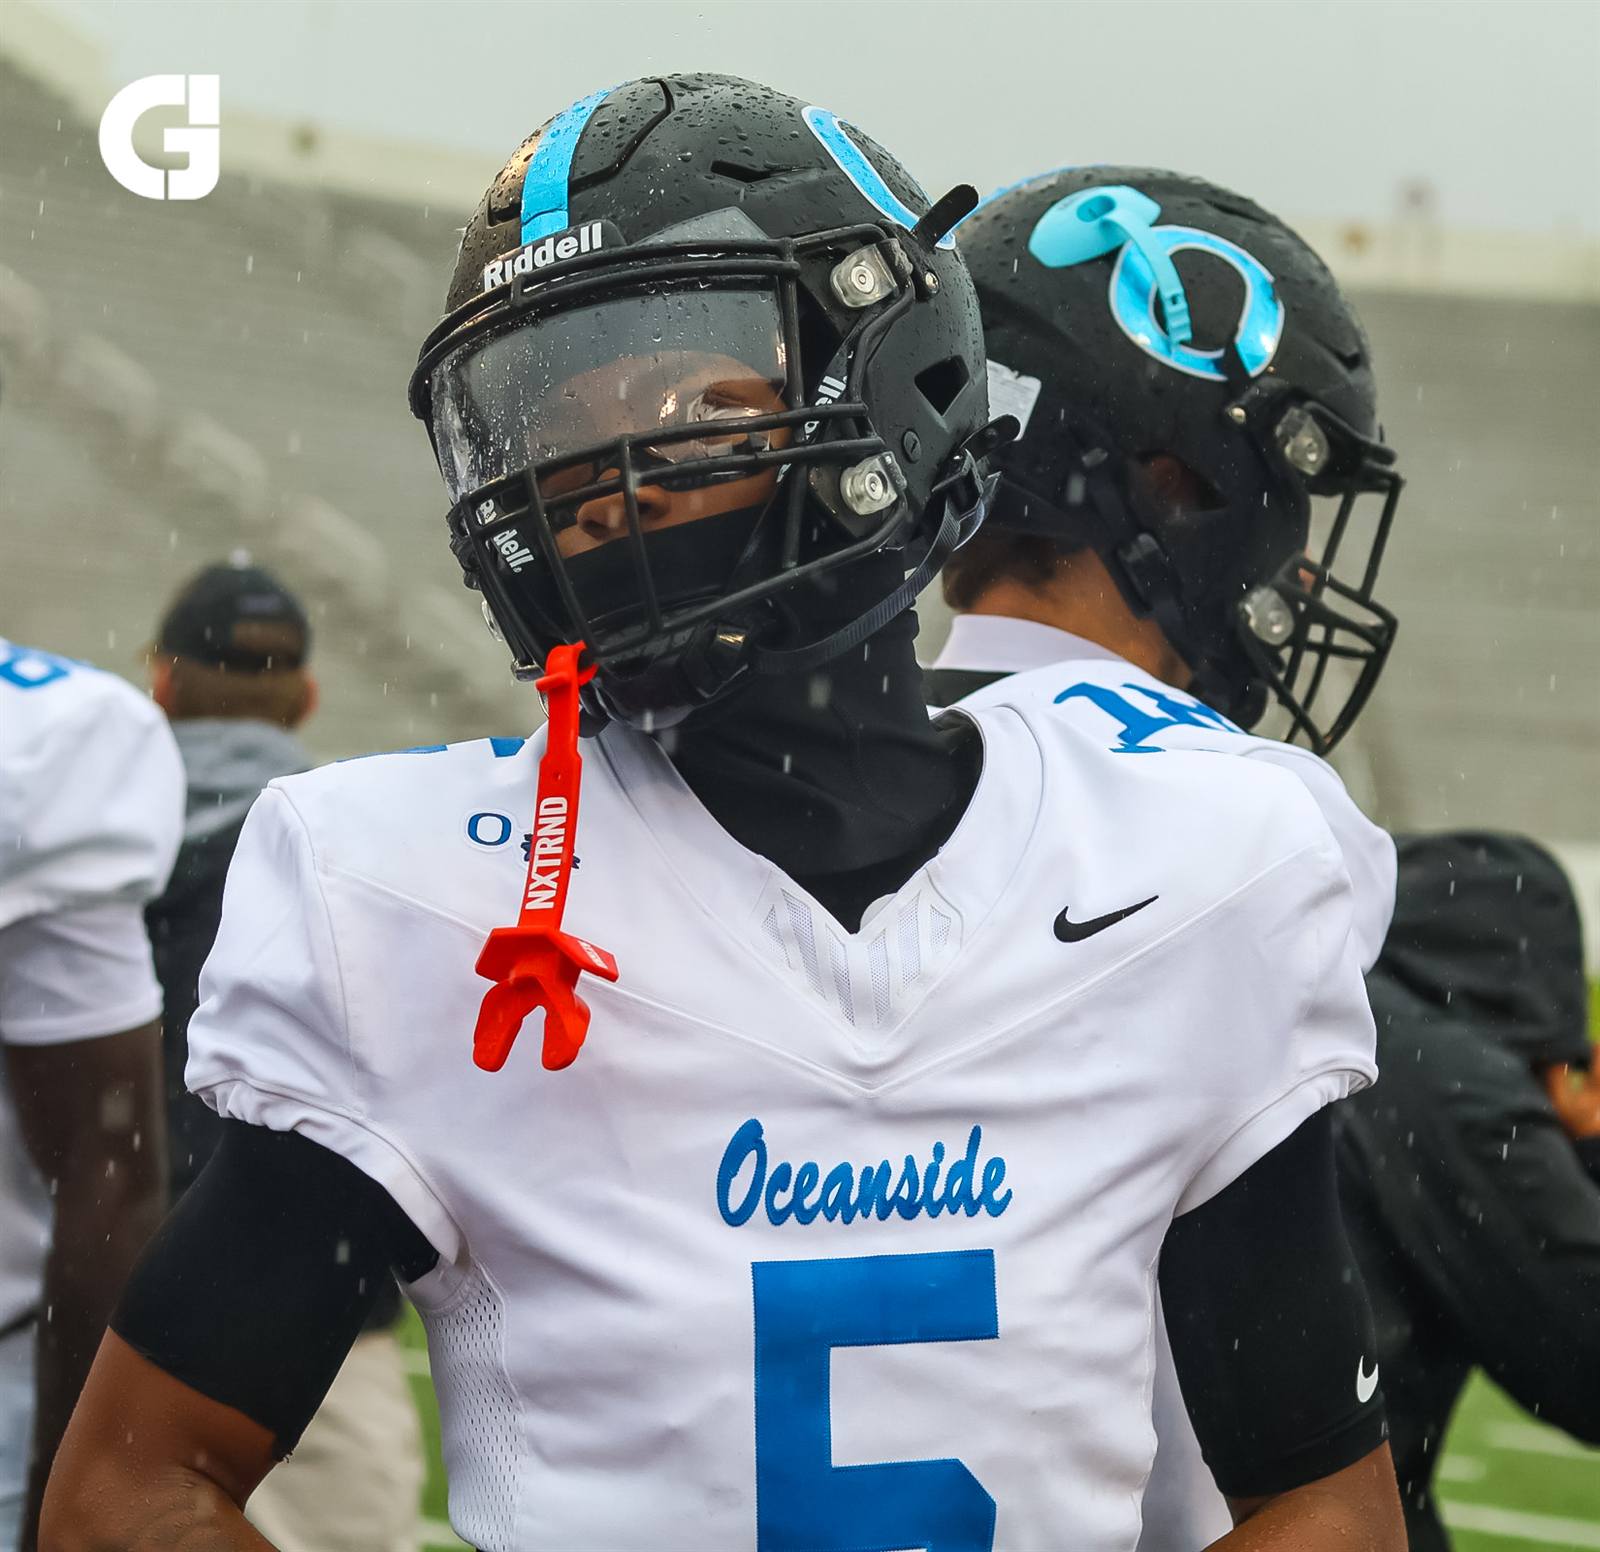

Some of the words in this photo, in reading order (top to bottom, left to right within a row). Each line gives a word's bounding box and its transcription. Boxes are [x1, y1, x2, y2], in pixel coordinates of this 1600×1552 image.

[484, 222, 602, 292] Riddell
[467, 812, 512, 846] O
[525, 796, 568, 910] NXTRND
[716, 1118, 1013, 1228] Oceanside
[751, 1248, 1000, 1552] 5
